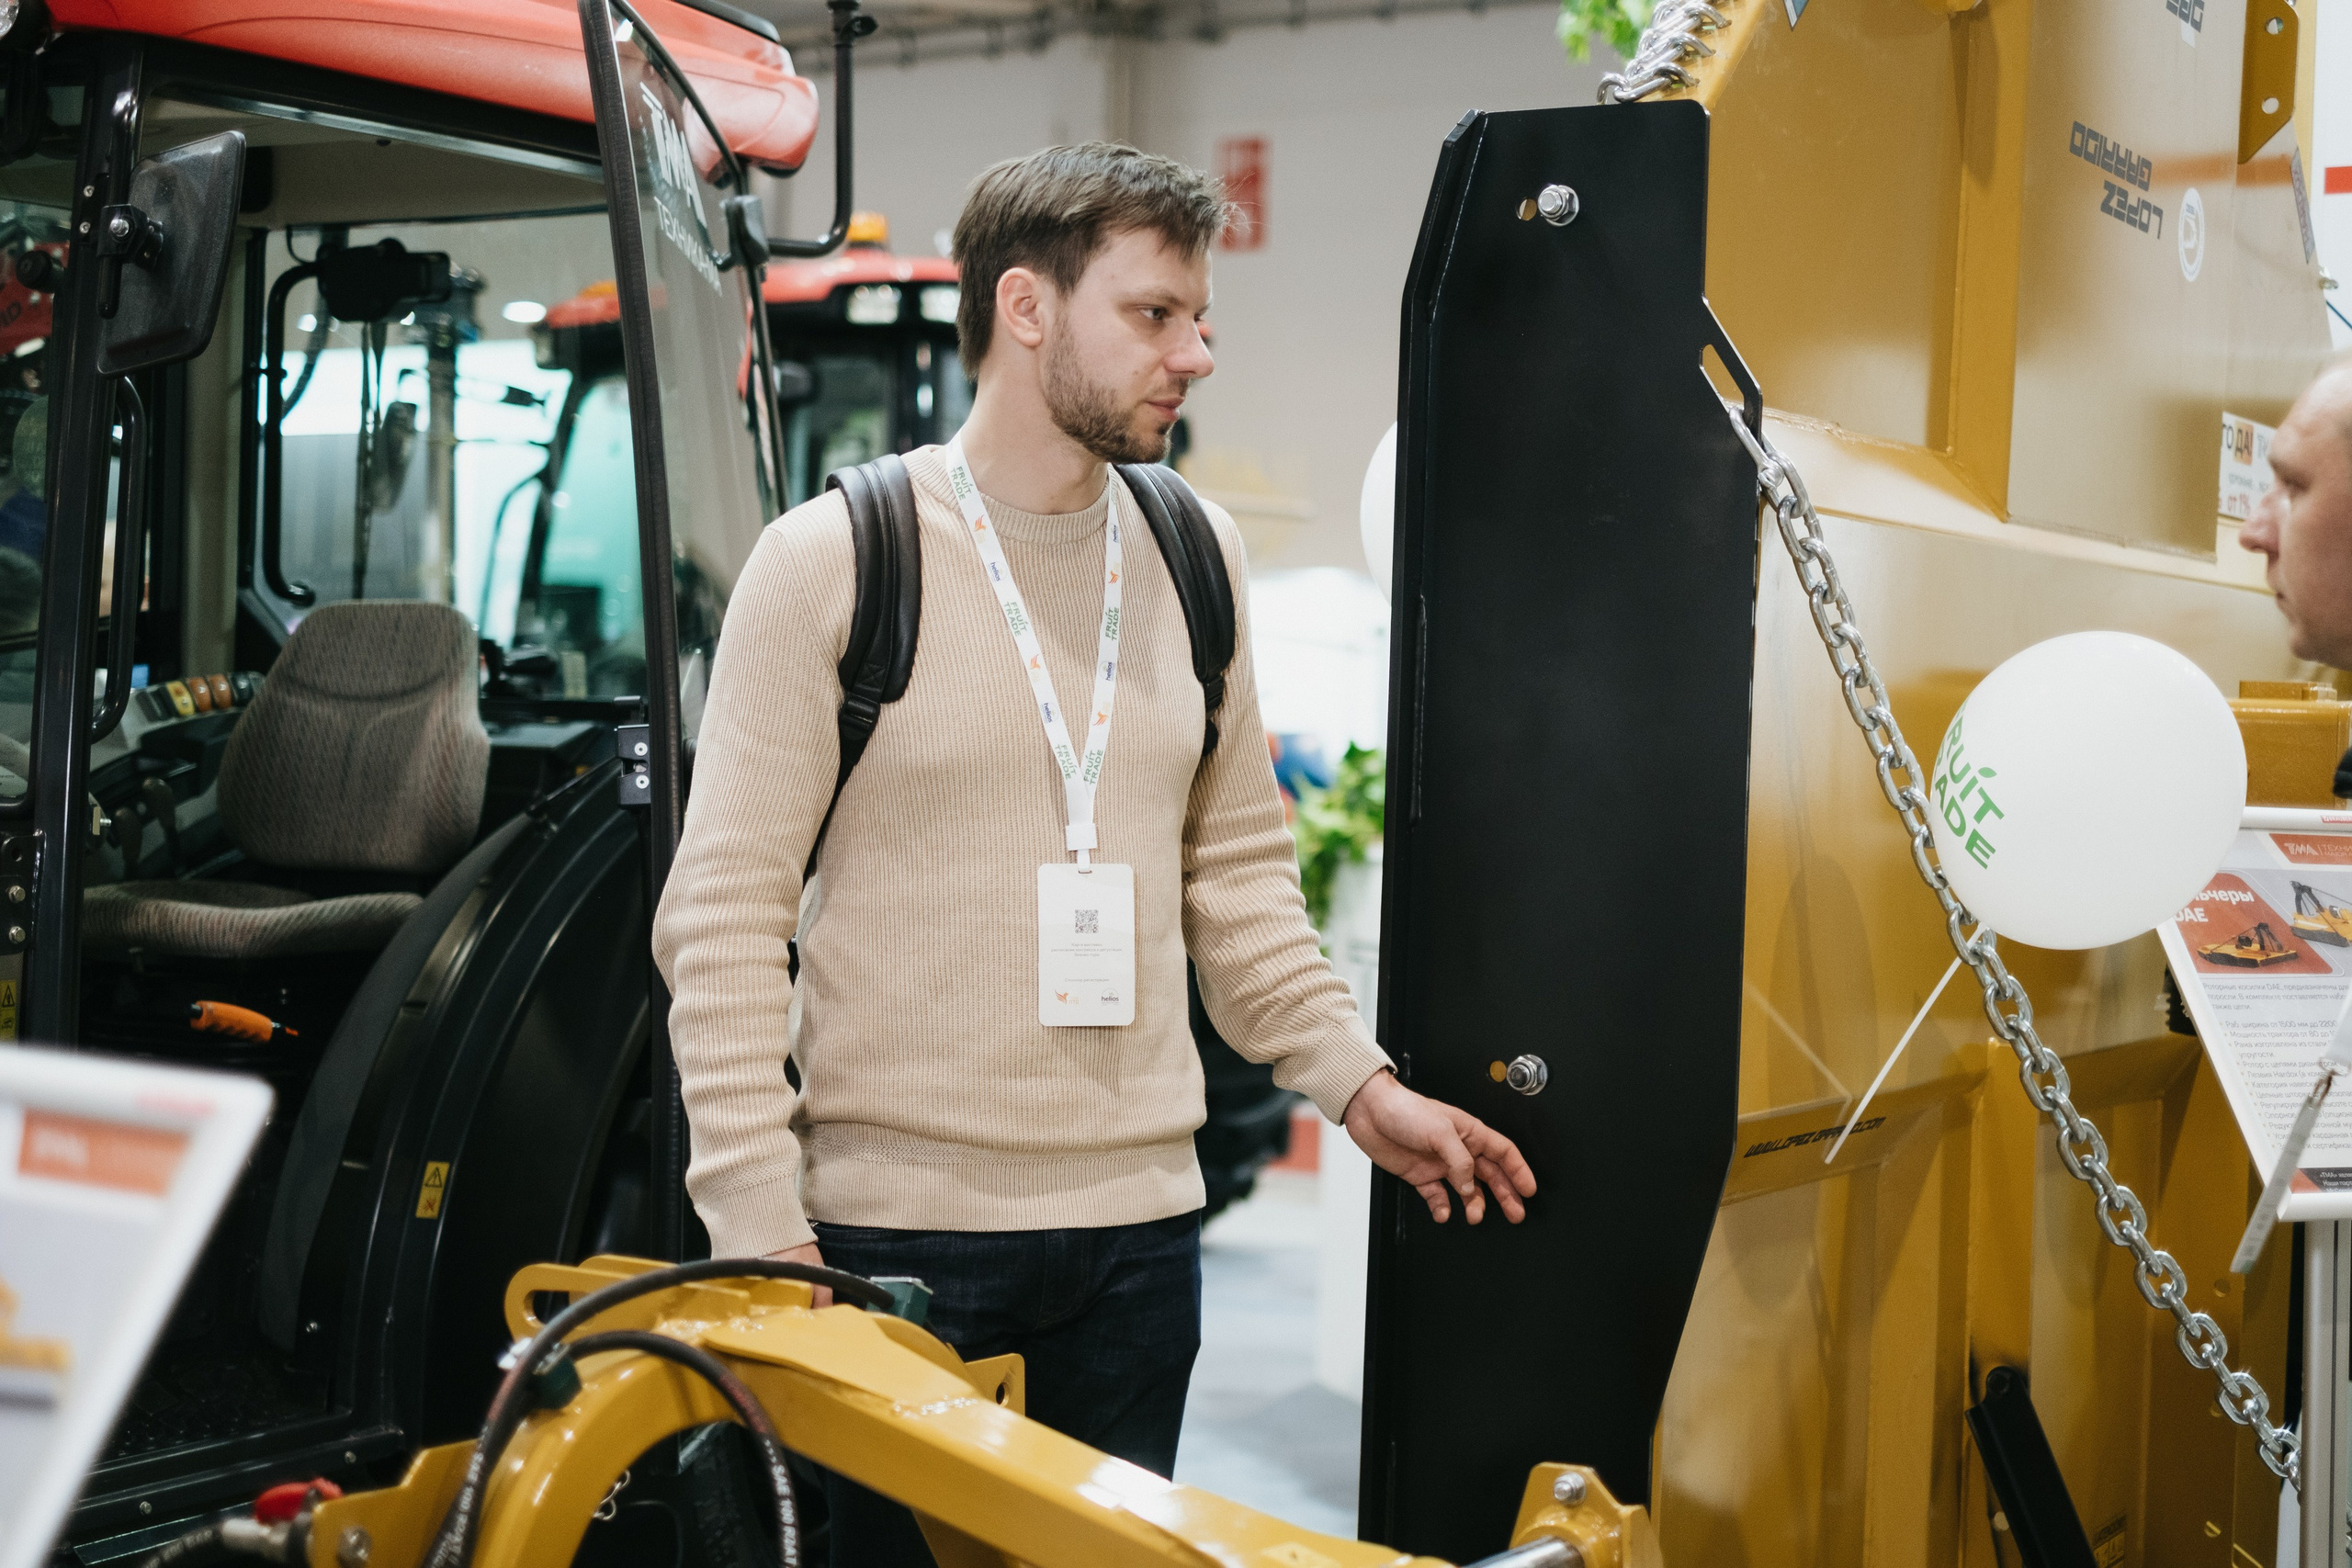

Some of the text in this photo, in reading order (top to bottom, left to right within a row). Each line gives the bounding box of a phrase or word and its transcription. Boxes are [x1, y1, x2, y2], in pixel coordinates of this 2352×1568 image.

[2069, 121, 2152, 192] GARRIDO
[2100, 180, 2163, 240] LOPEZ
[950, 468, 966, 501] TRADE
[990, 561, 1001, 582] helios
[1003, 602, 1022, 637] TRADE
[1112, 607, 1120, 641] TRADE
[1043, 702, 1053, 723] helios
[1055, 744, 1071, 780] TRADE
[1090, 750, 1103, 784] TRADE
[2196, 890, 2255, 905] ьчеры
[2230, 1031, 2267, 1039] Мощность
[2243, 1061, 2264, 1069] Ротор
[2256, 1091, 2283, 1100] Цепные
[772, 1464, 790, 1495] SAE
[779, 1498, 795, 1525] 100
